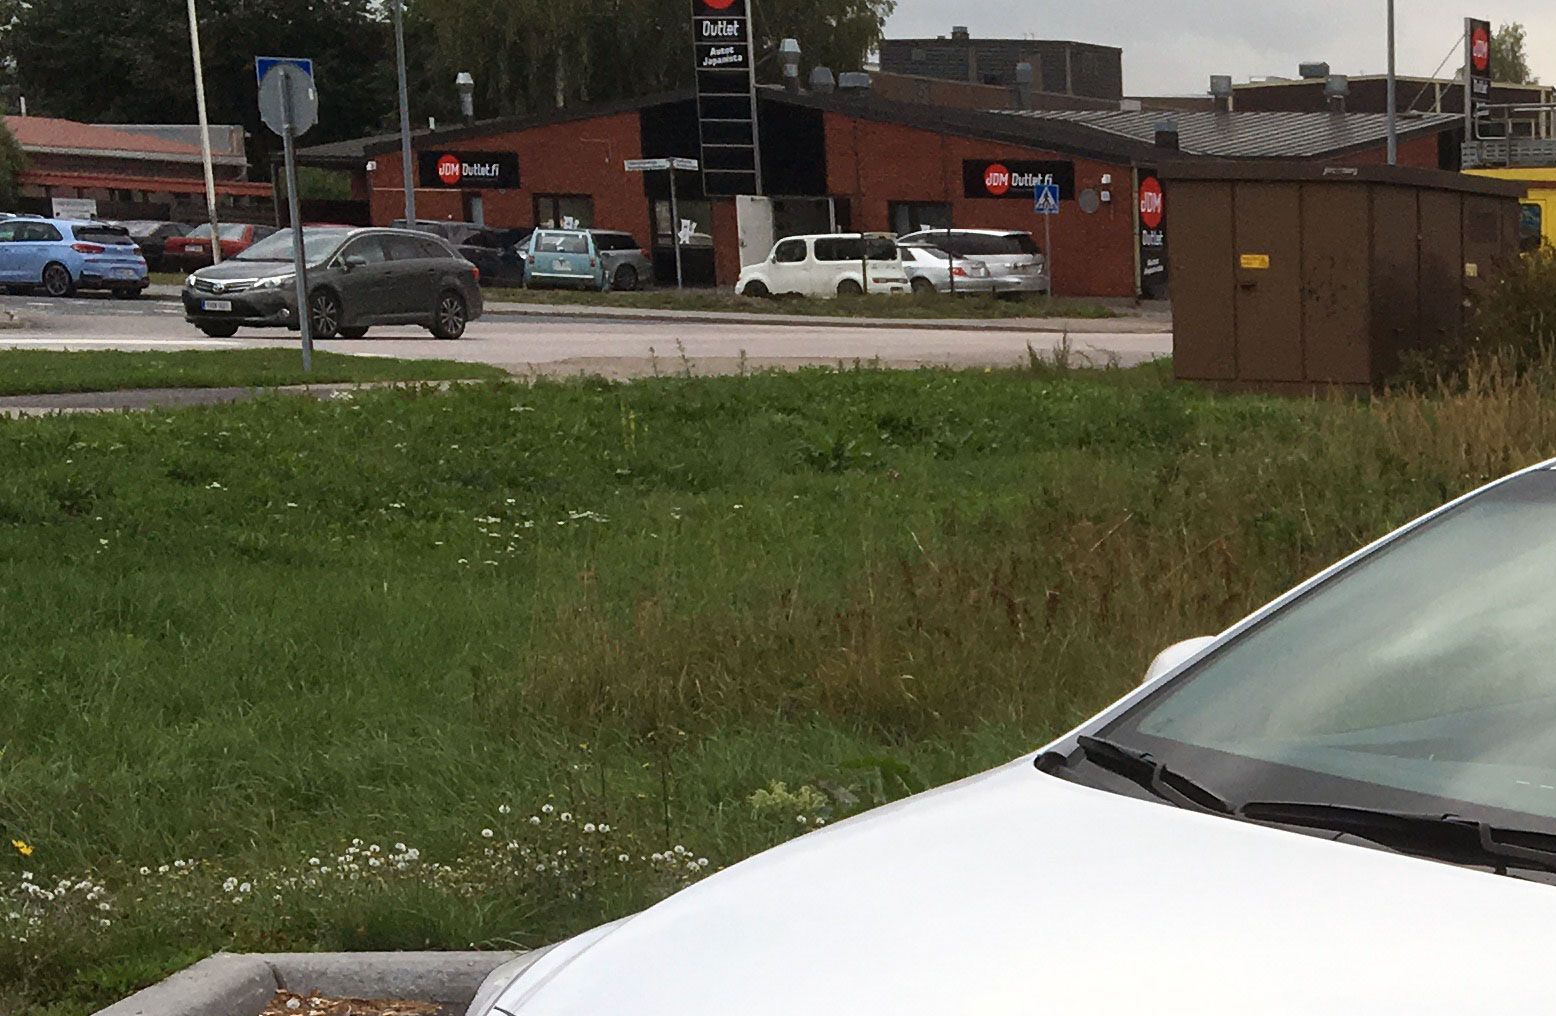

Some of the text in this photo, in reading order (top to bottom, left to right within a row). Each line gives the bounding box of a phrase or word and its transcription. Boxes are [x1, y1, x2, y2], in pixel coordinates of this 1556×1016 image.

[702, 20, 739, 36] Outlet
[438, 162, 499, 176] JDM Outlet.fi
[985, 172, 1053, 187] JDM Outletfi
[1140, 191, 1162, 213] JDM
